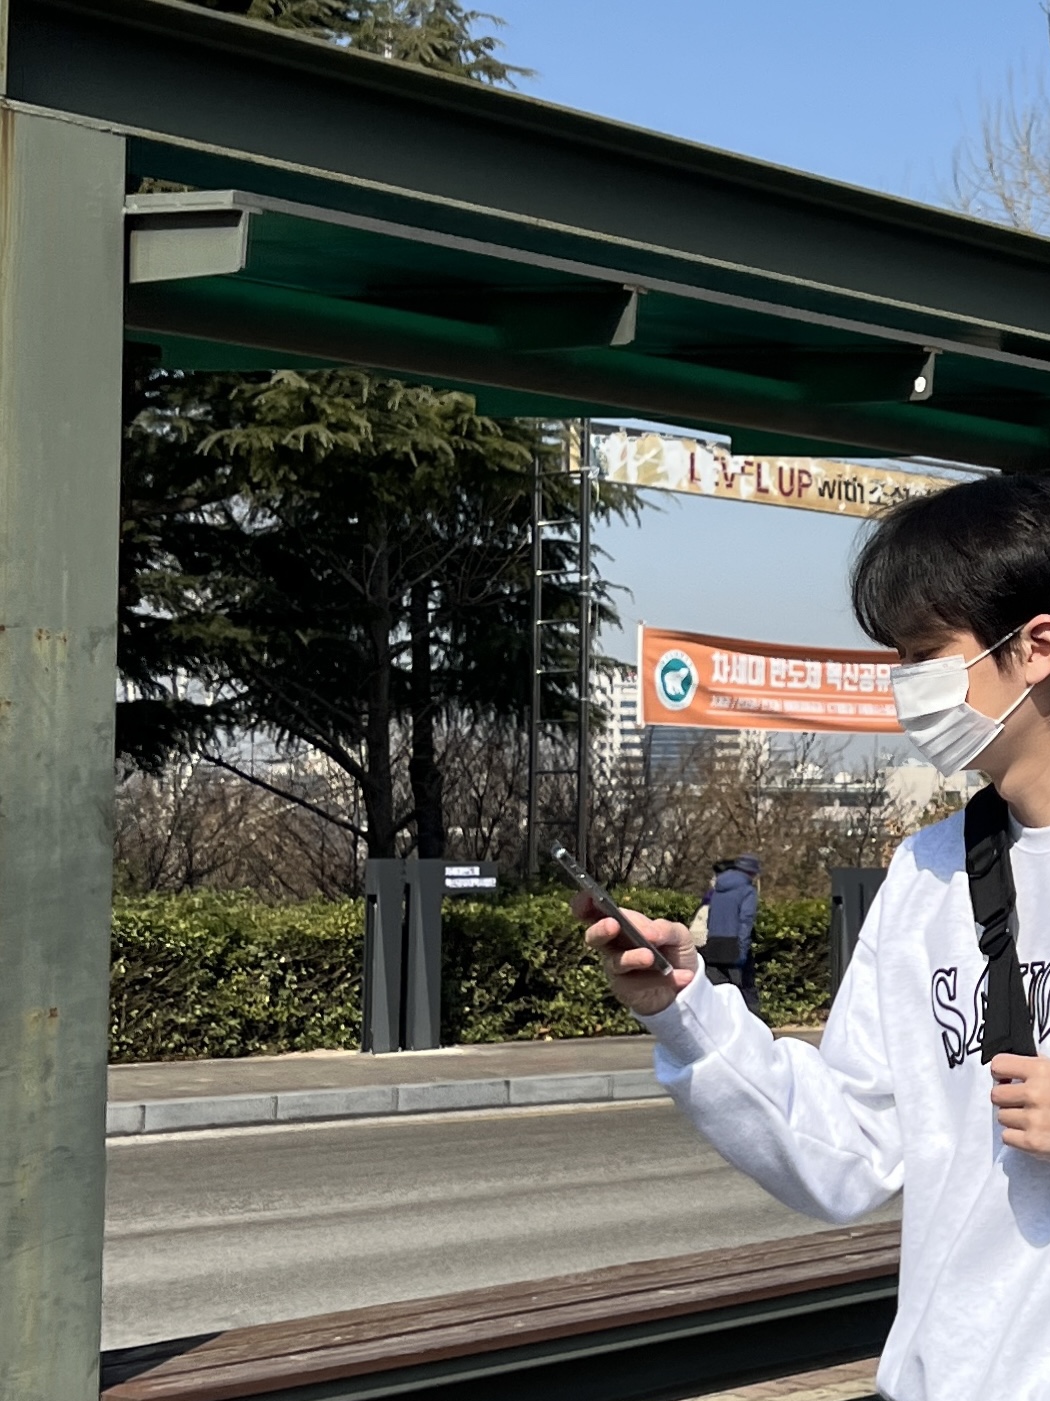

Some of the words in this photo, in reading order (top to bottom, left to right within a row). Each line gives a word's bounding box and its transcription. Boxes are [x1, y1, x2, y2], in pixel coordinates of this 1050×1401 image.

[778, 466, 813, 498] UP
[817, 473, 865, 504] with
[825, 659, 901, 694] 혁신공유
